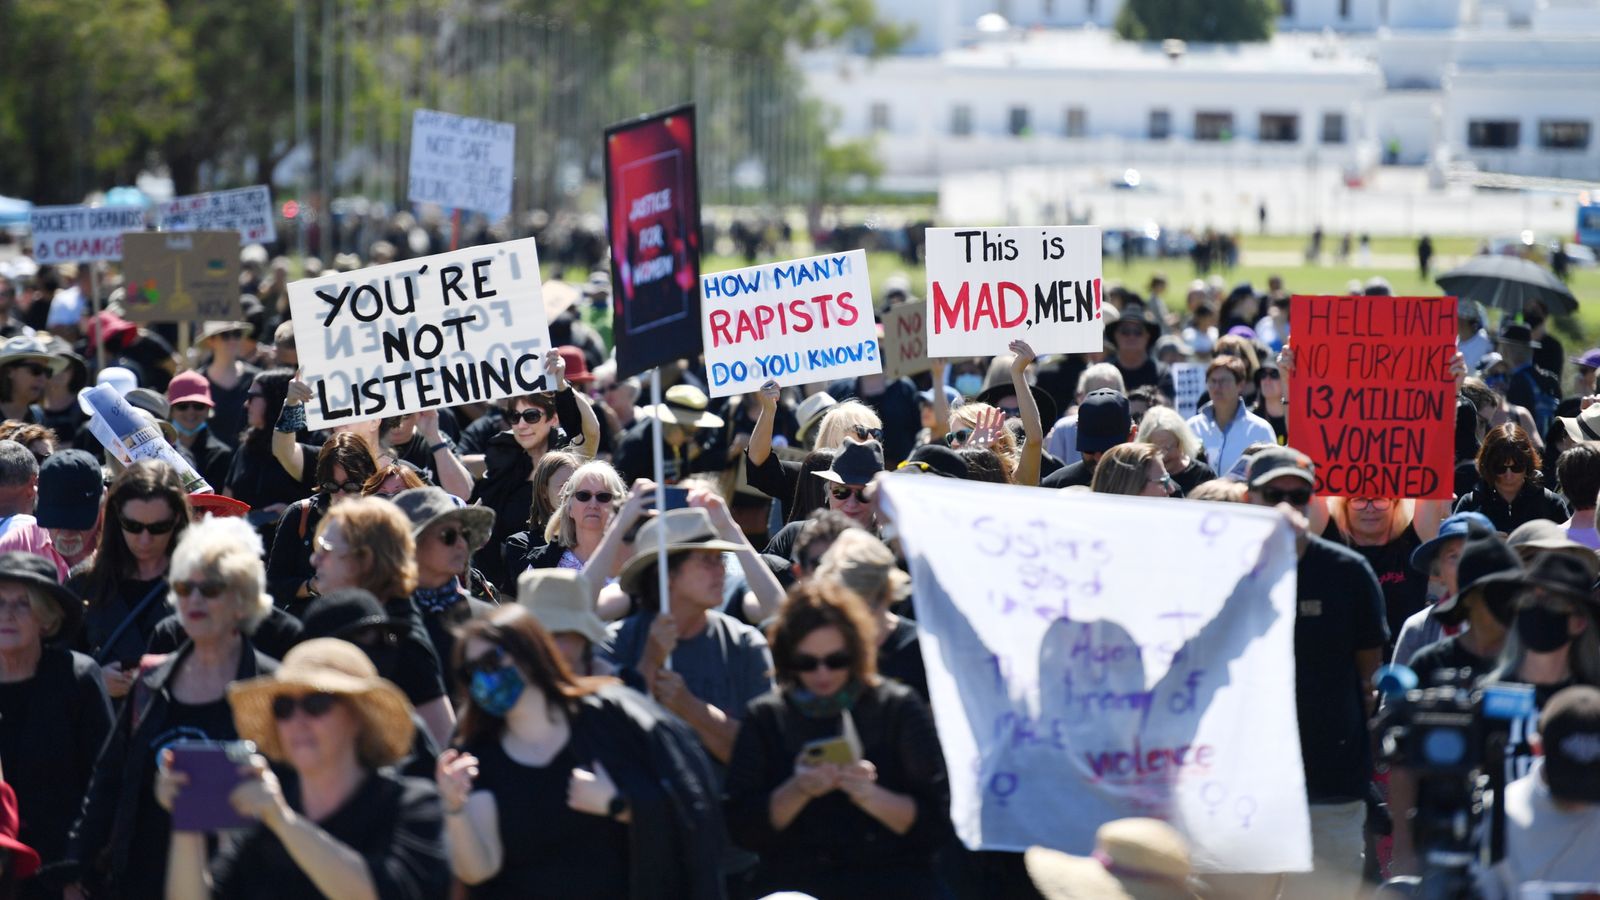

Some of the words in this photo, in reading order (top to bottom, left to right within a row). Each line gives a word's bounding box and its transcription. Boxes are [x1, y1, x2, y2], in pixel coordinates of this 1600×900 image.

[31, 212, 84, 233] SOCIETY
[88, 210, 143, 230] DEMANDS
[629, 188, 672, 221] JUSTICE
[54, 234, 123, 259] CHANGE
[639, 224, 665, 251] FOR
[954, 231, 1019, 263] This
[1042, 231, 1065, 261] is
[633, 254, 674, 287] WOMEN
[704, 271, 761, 299] HOW
[773, 255, 847, 290] MANY
[315, 260, 497, 327] YOU'RE
[709, 291, 859, 348] RAPISTS
[897, 312, 922, 337] NO
[1309, 298, 1384, 336] HELL
[1393, 298, 1456, 336] HATH
[383, 315, 476, 364] NOT
[899, 336, 923, 361] NO
[712, 361, 748, 387] DO
[755, 352, 800, 377] YOU
[808, 340, 876, 370] KNOW?
[1291, 343, 1330, 379] NO
[1346, 342, 1404, 380] FURY
[1405, 344, 1457, 383] LIKE
[317, 353, 547, 421] LISTENING
[1306, 384, 1335, 419] 13
[1338, 387, 1445, 421] MILLION
[1319, 424, 1426, 465] WOMEN
[1313, 463, 1440, 498] SCORNED
[1167, 670, 1206, 716] of
[1084, 735, 1214, 776] violence
